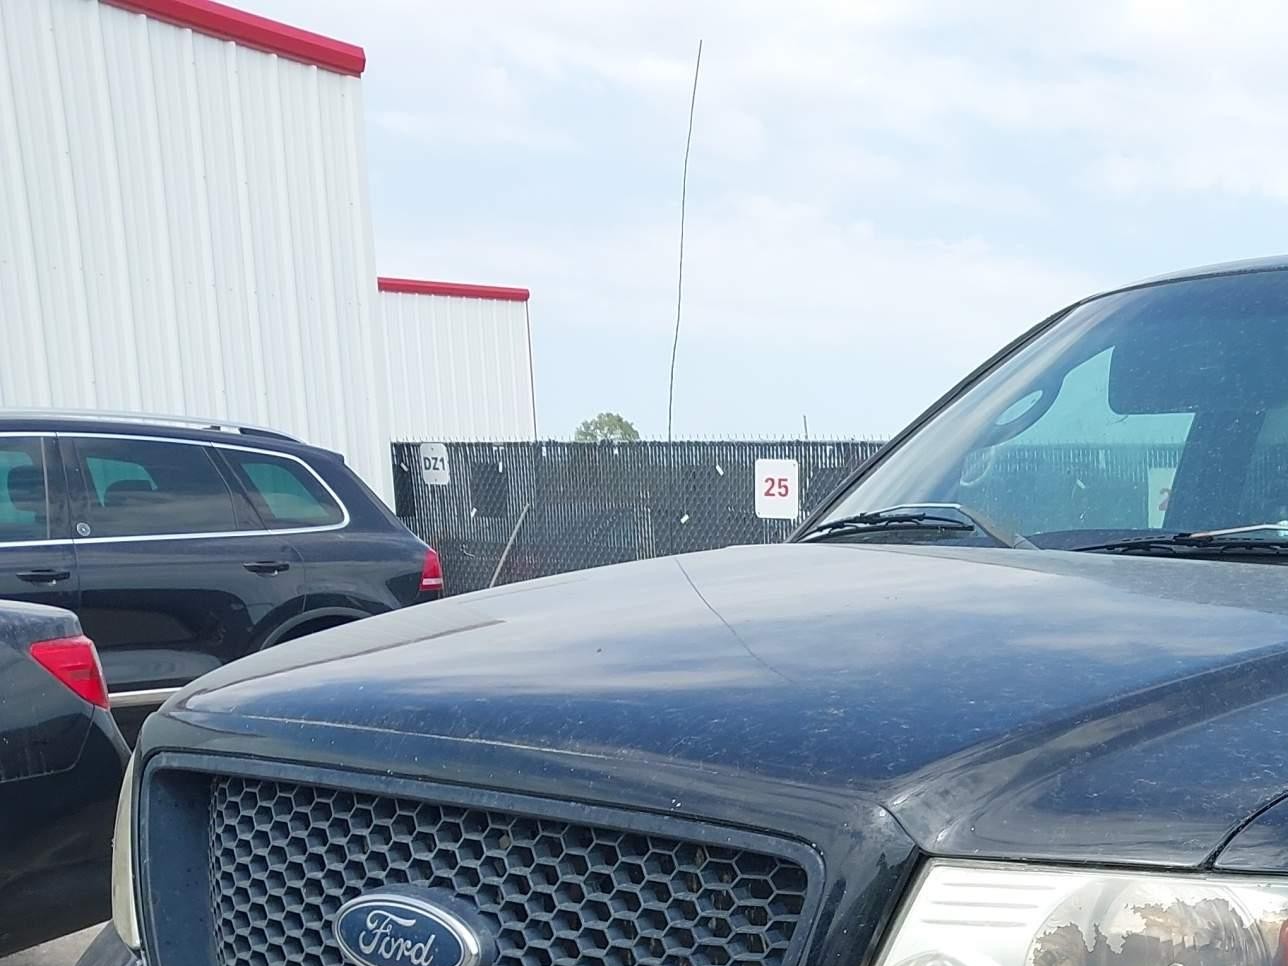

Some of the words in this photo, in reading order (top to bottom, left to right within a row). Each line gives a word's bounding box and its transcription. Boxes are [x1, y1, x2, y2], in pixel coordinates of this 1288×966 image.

[423, 457, 446, 471] DZ1
[764, 477, 789, 497] 25
[359, 909, 436, 966] Ford
